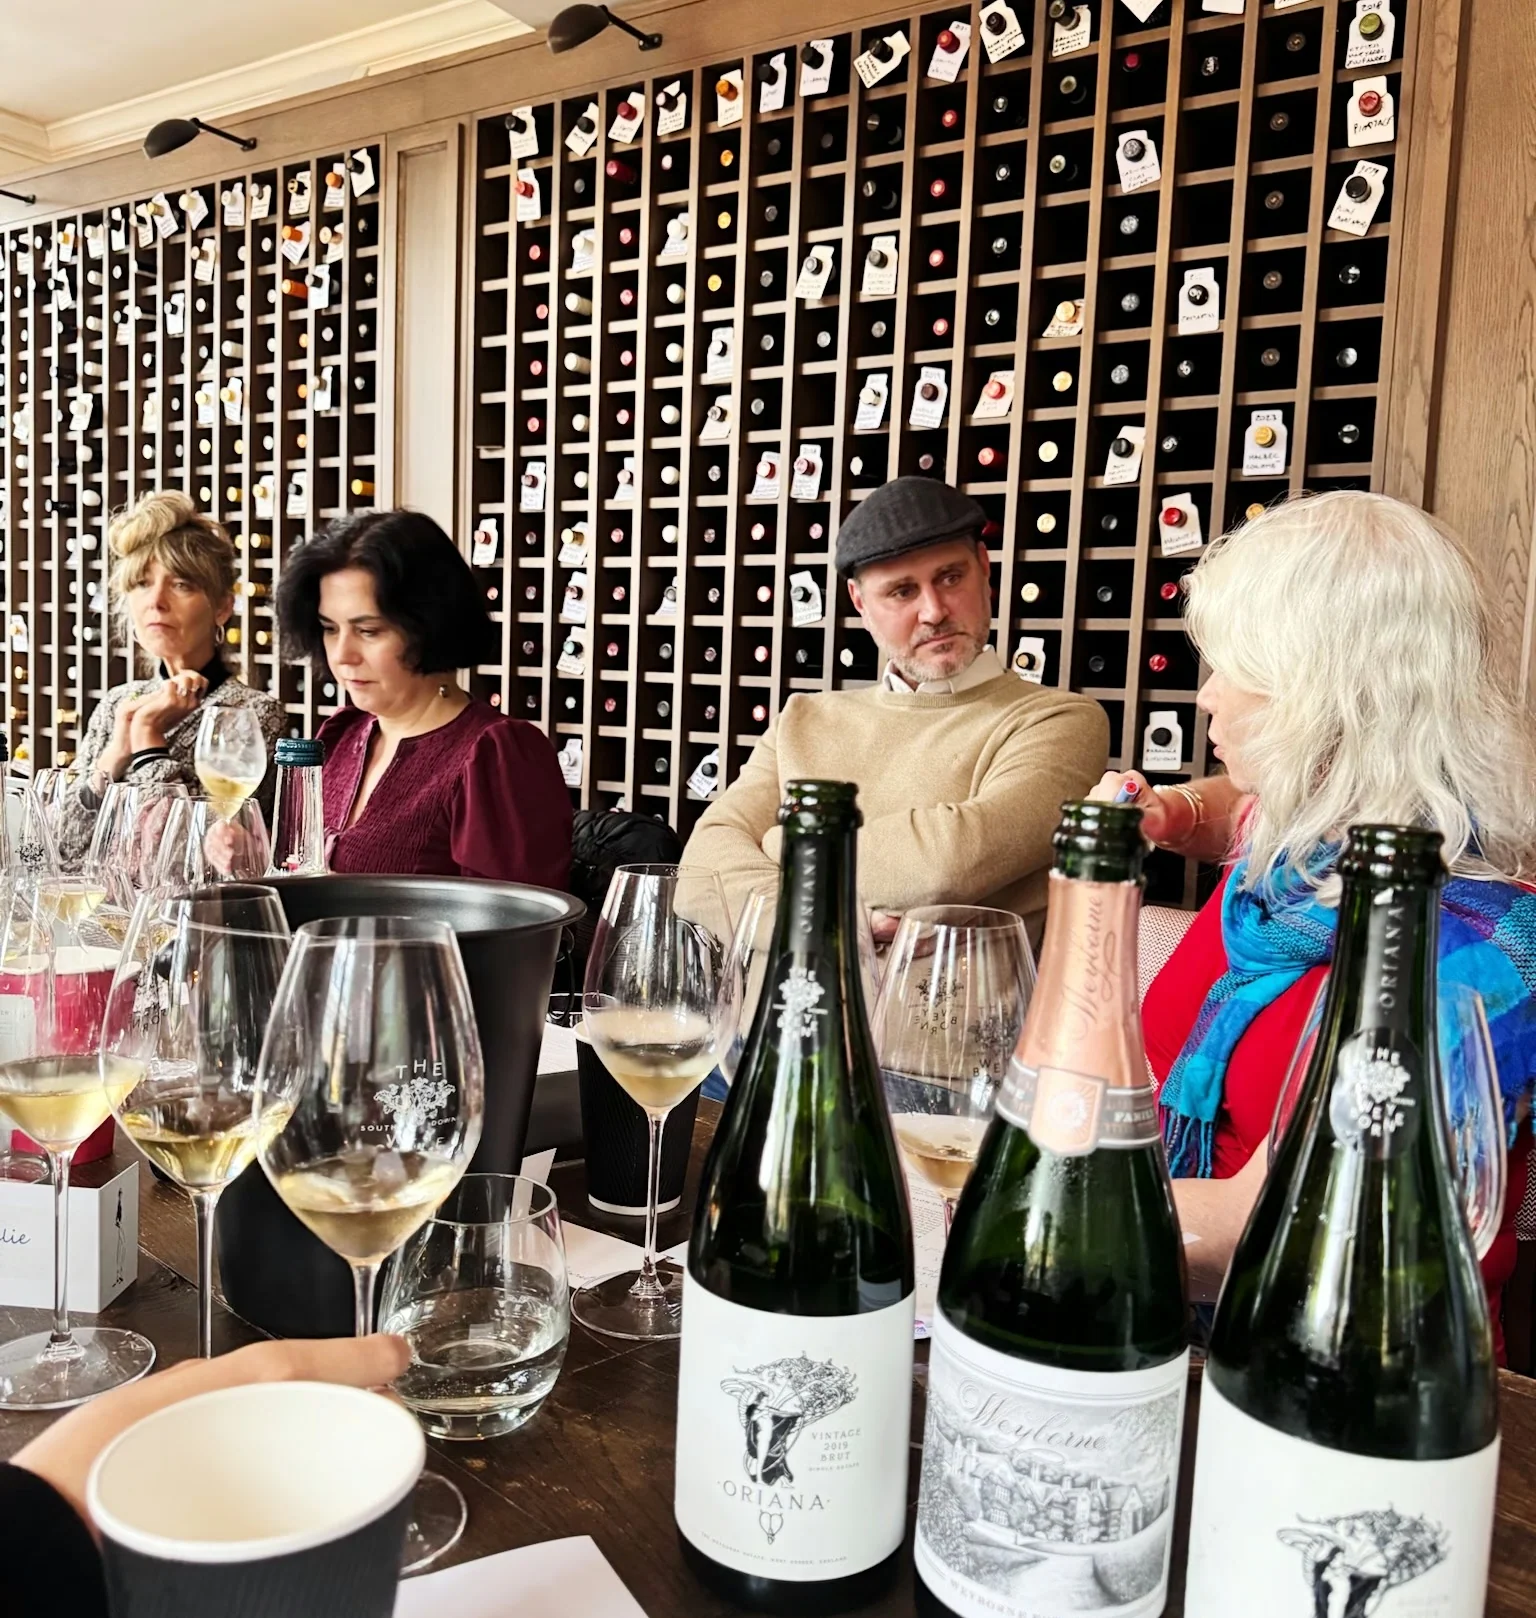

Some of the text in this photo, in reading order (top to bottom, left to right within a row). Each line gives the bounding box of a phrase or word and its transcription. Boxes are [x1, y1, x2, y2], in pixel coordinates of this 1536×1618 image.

[1378, 906, 1405, 1009] ORIANA
[1364, 1046, 1401, 1067] THE
[395, 1058, 444, 1080] THE
[811, 1427, 862, 1441] VINTAGE
[820, 1451, 851, 1462] BRUT
[824, 1441, 849, 1451] 2019
[722, 1479, 825, 1511] ORIANA
